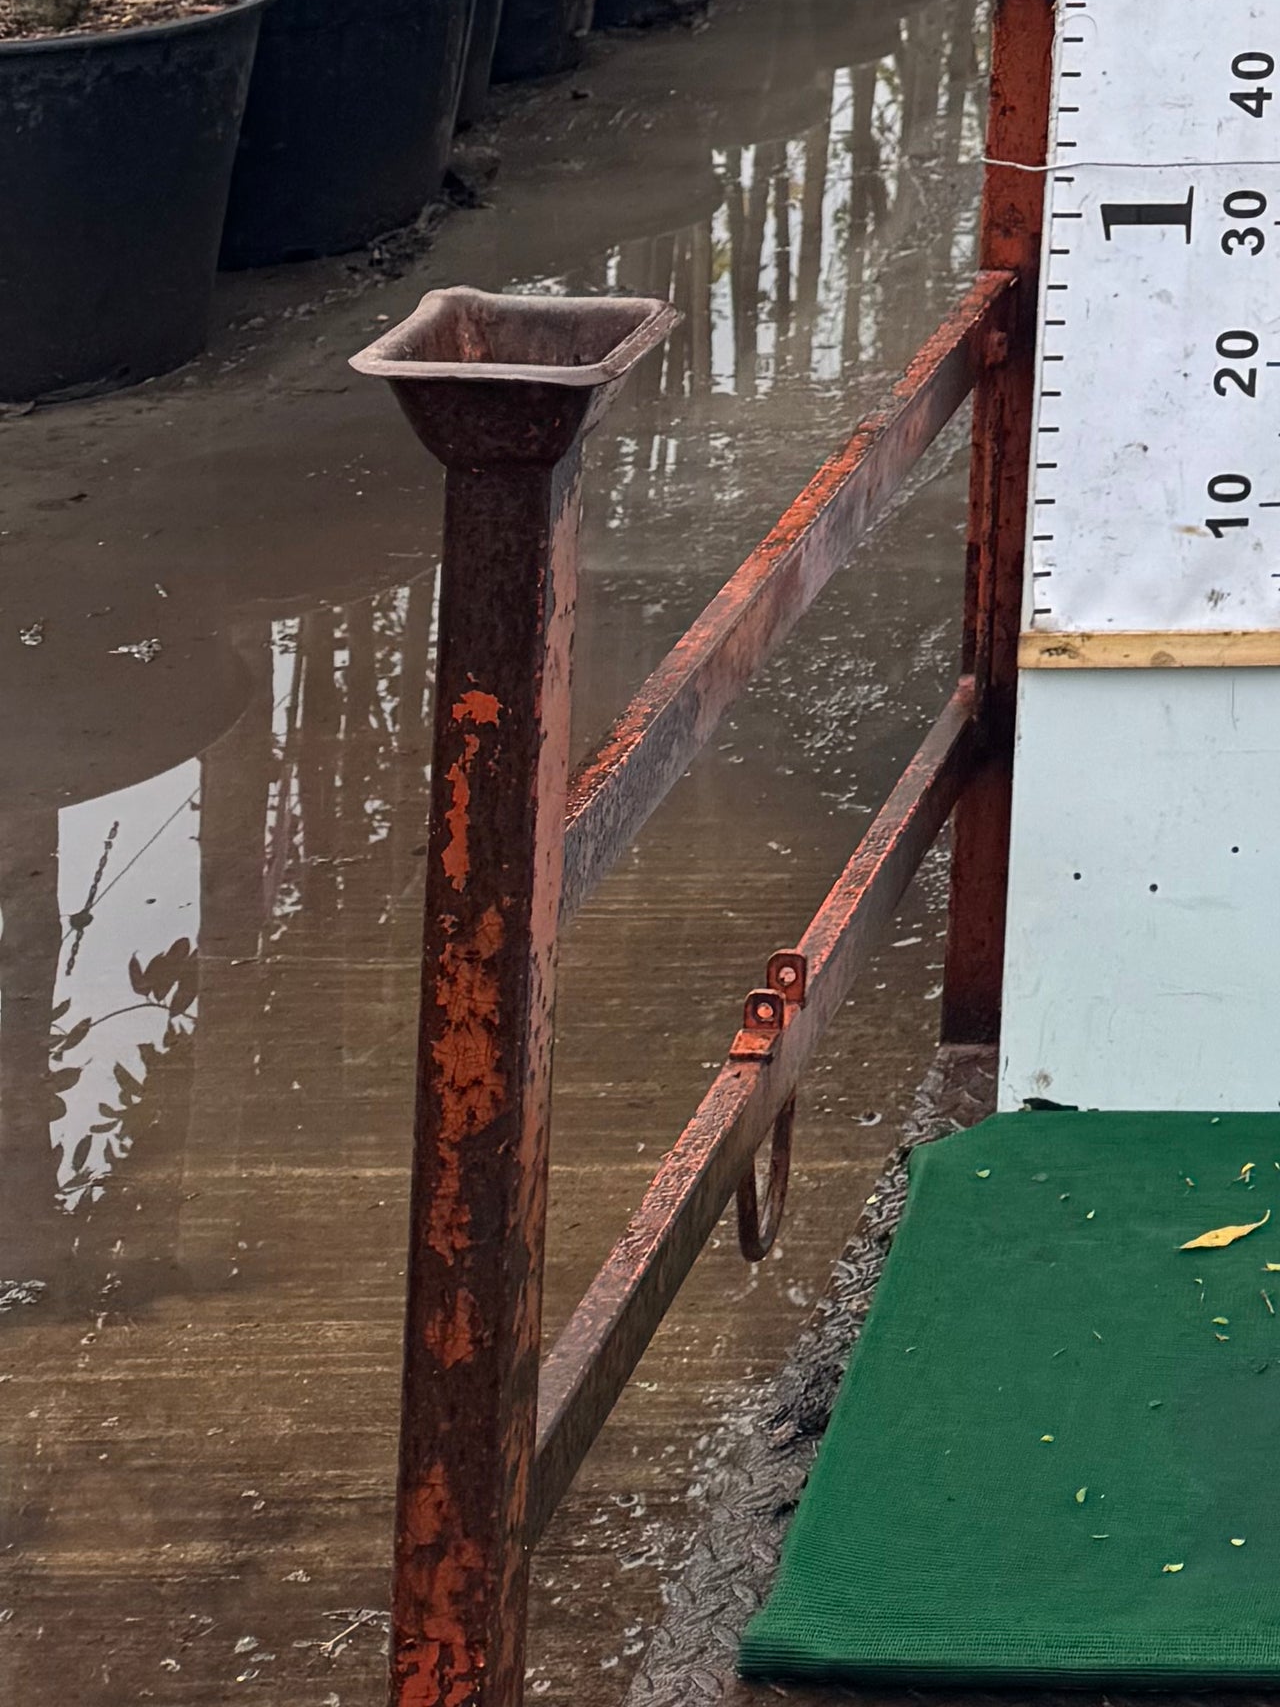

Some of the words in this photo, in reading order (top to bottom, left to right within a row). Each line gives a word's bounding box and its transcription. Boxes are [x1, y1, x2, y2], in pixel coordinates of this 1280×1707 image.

[1229, 51, 1275, 119] 40
[1099, 185, 1195, 245] 1
[1221, 190, 1267, 256] 30
[1213, 330, 1259, 398] 20
[1205, 473, 1252, 539] 10
